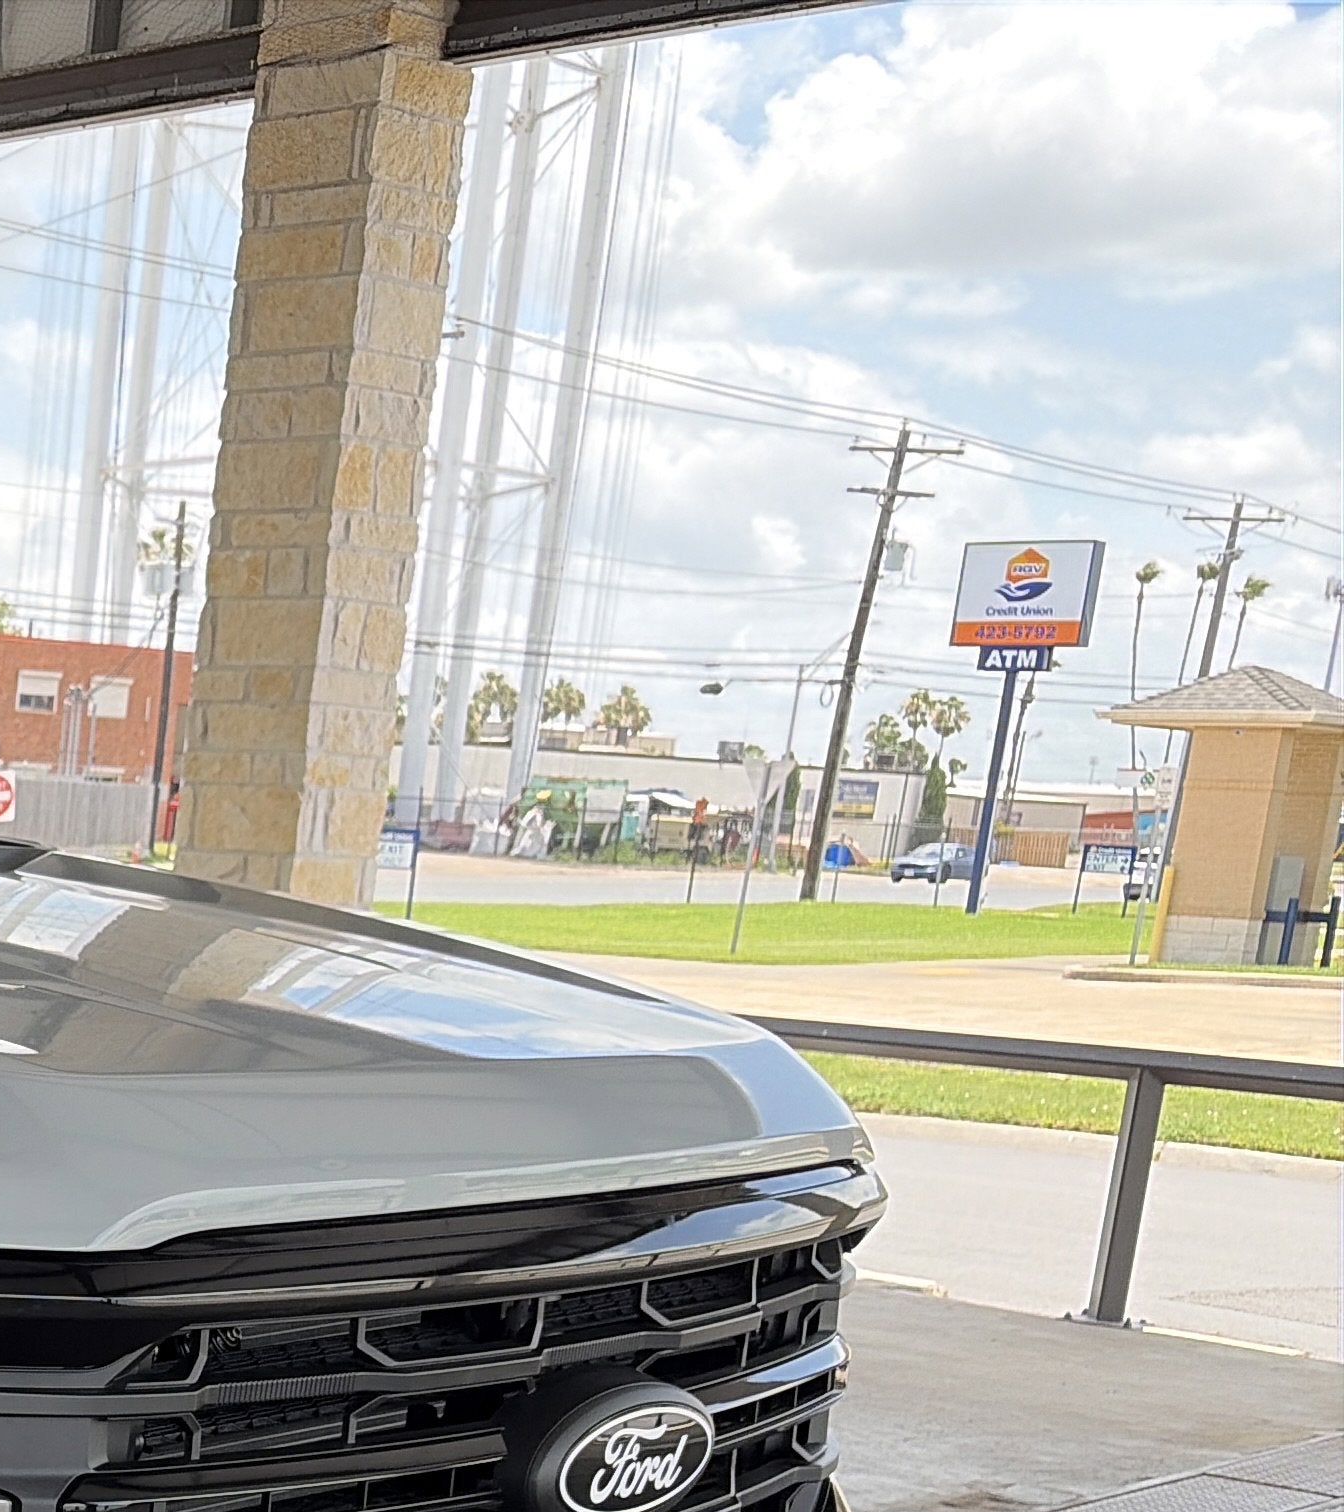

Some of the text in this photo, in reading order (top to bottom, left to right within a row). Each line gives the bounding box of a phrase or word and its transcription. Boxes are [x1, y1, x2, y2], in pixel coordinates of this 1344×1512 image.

[985, 605, 1054, 617] Credit Union
[975, 625, 1057, 640] 423-5792
[984, 649, 1039, 669] ATM
[589, 1423, 689, 1505] Ford
